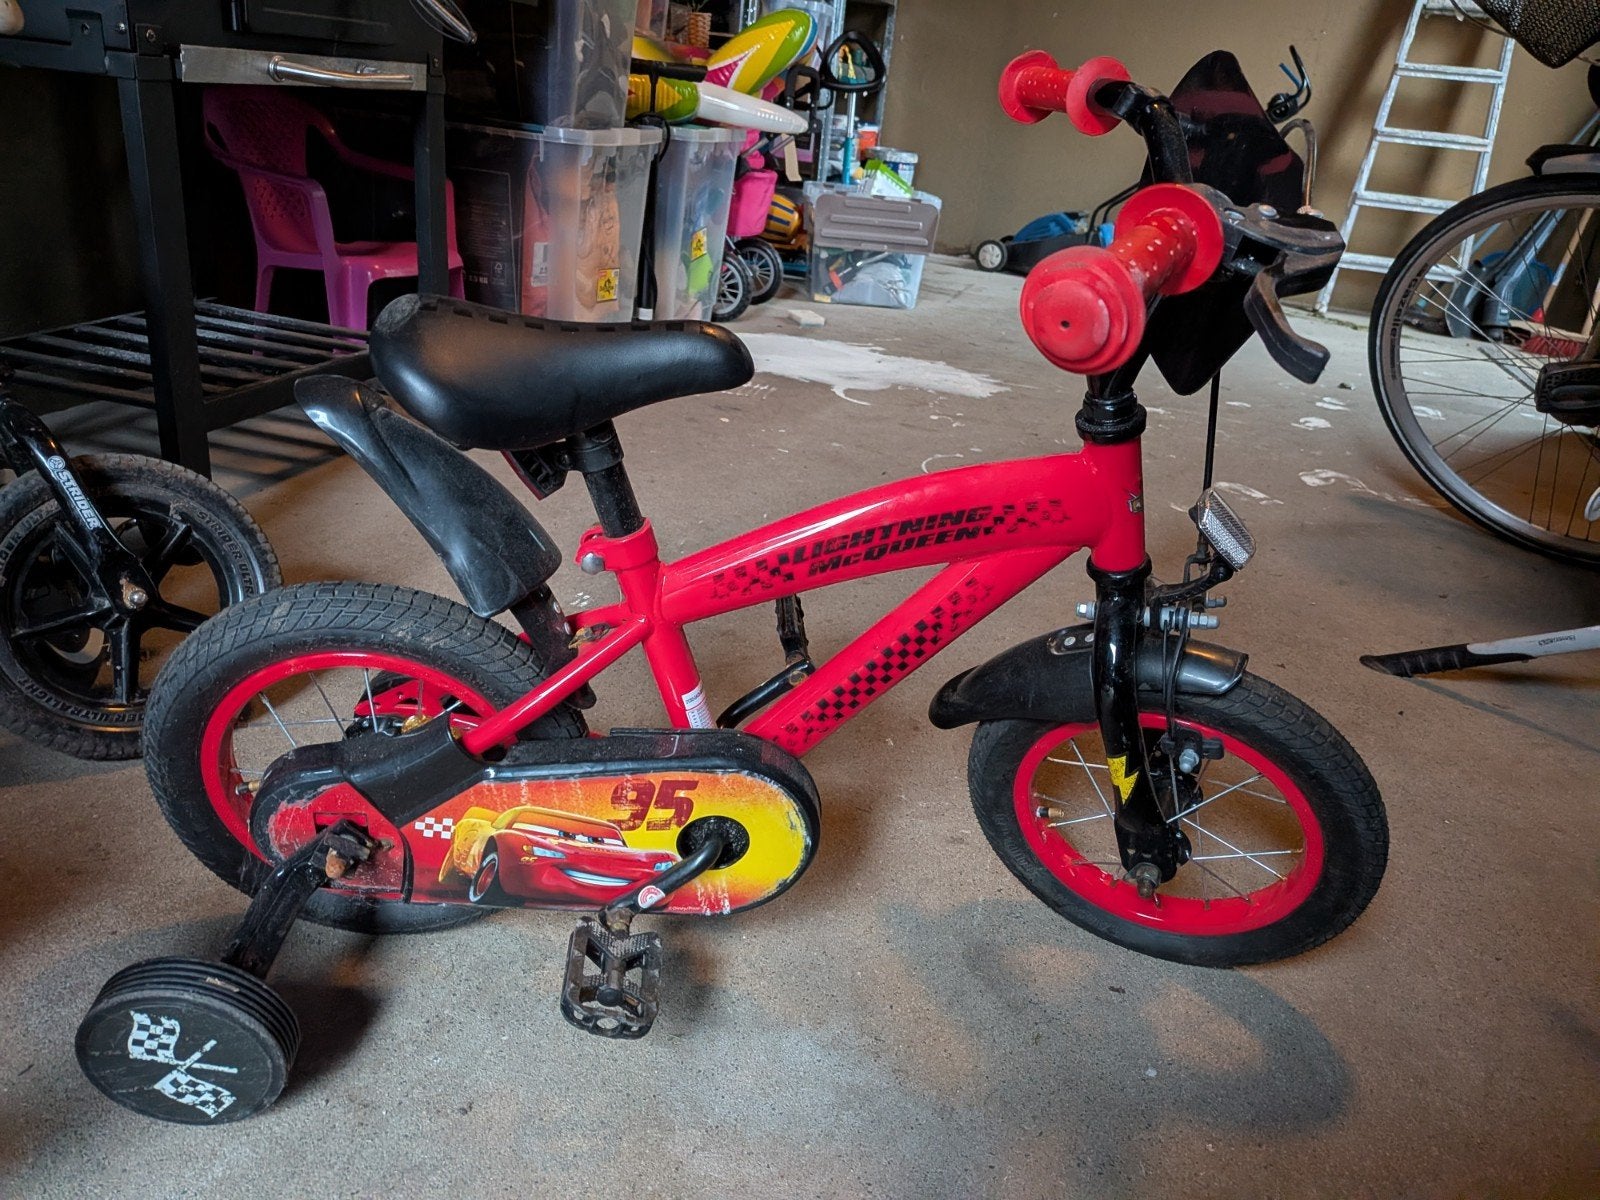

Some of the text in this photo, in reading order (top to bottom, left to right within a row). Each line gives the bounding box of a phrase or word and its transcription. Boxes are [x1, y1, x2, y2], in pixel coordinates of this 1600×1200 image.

[59, 468, 103, 530] STRIDER
[197, 511, 256, 599] STRIDER ULTR
[792, 505, 993, 565] LIGHTNING
[17, 676, 111, 722] ULTRALIGHT
[607, 779, 699, 832] 95
